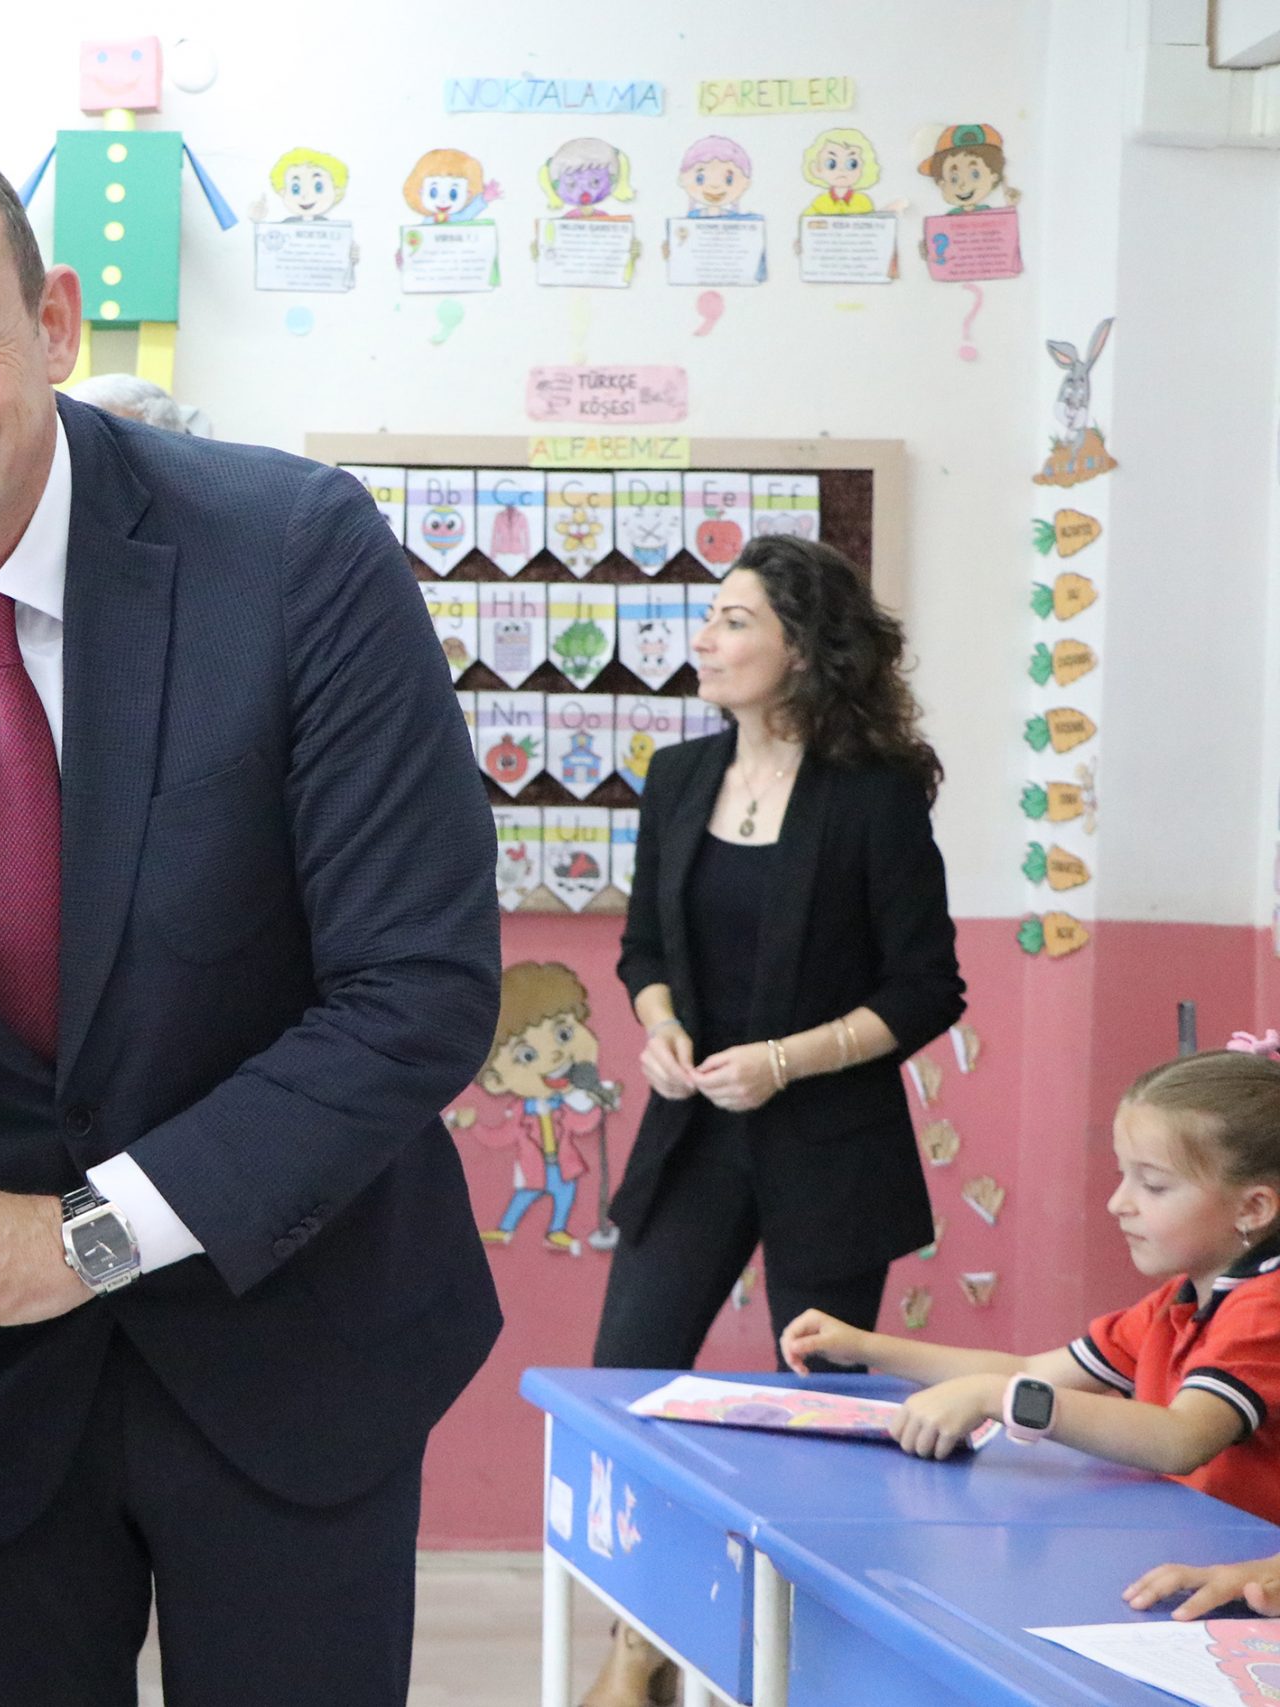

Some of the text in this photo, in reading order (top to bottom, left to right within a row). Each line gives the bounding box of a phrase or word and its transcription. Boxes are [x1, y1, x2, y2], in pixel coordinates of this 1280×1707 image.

[577, 370, 637, 393] TÜRKÇE
[426, 478, 462, 506] Bb
[492, 478, 533, 506] Cc
[628, 479, 670, 506] Dd
[702, 480, 737, 508] Ee
[766, 482, 802, 510] Ff
[491, 591, 537, 619] Hh
[491, 701, 532, 727] Nn
[560, 701, 602, 730] Oo
[629, 698, 671, 732] Öö
[556, 814, 598, 842] Uu
